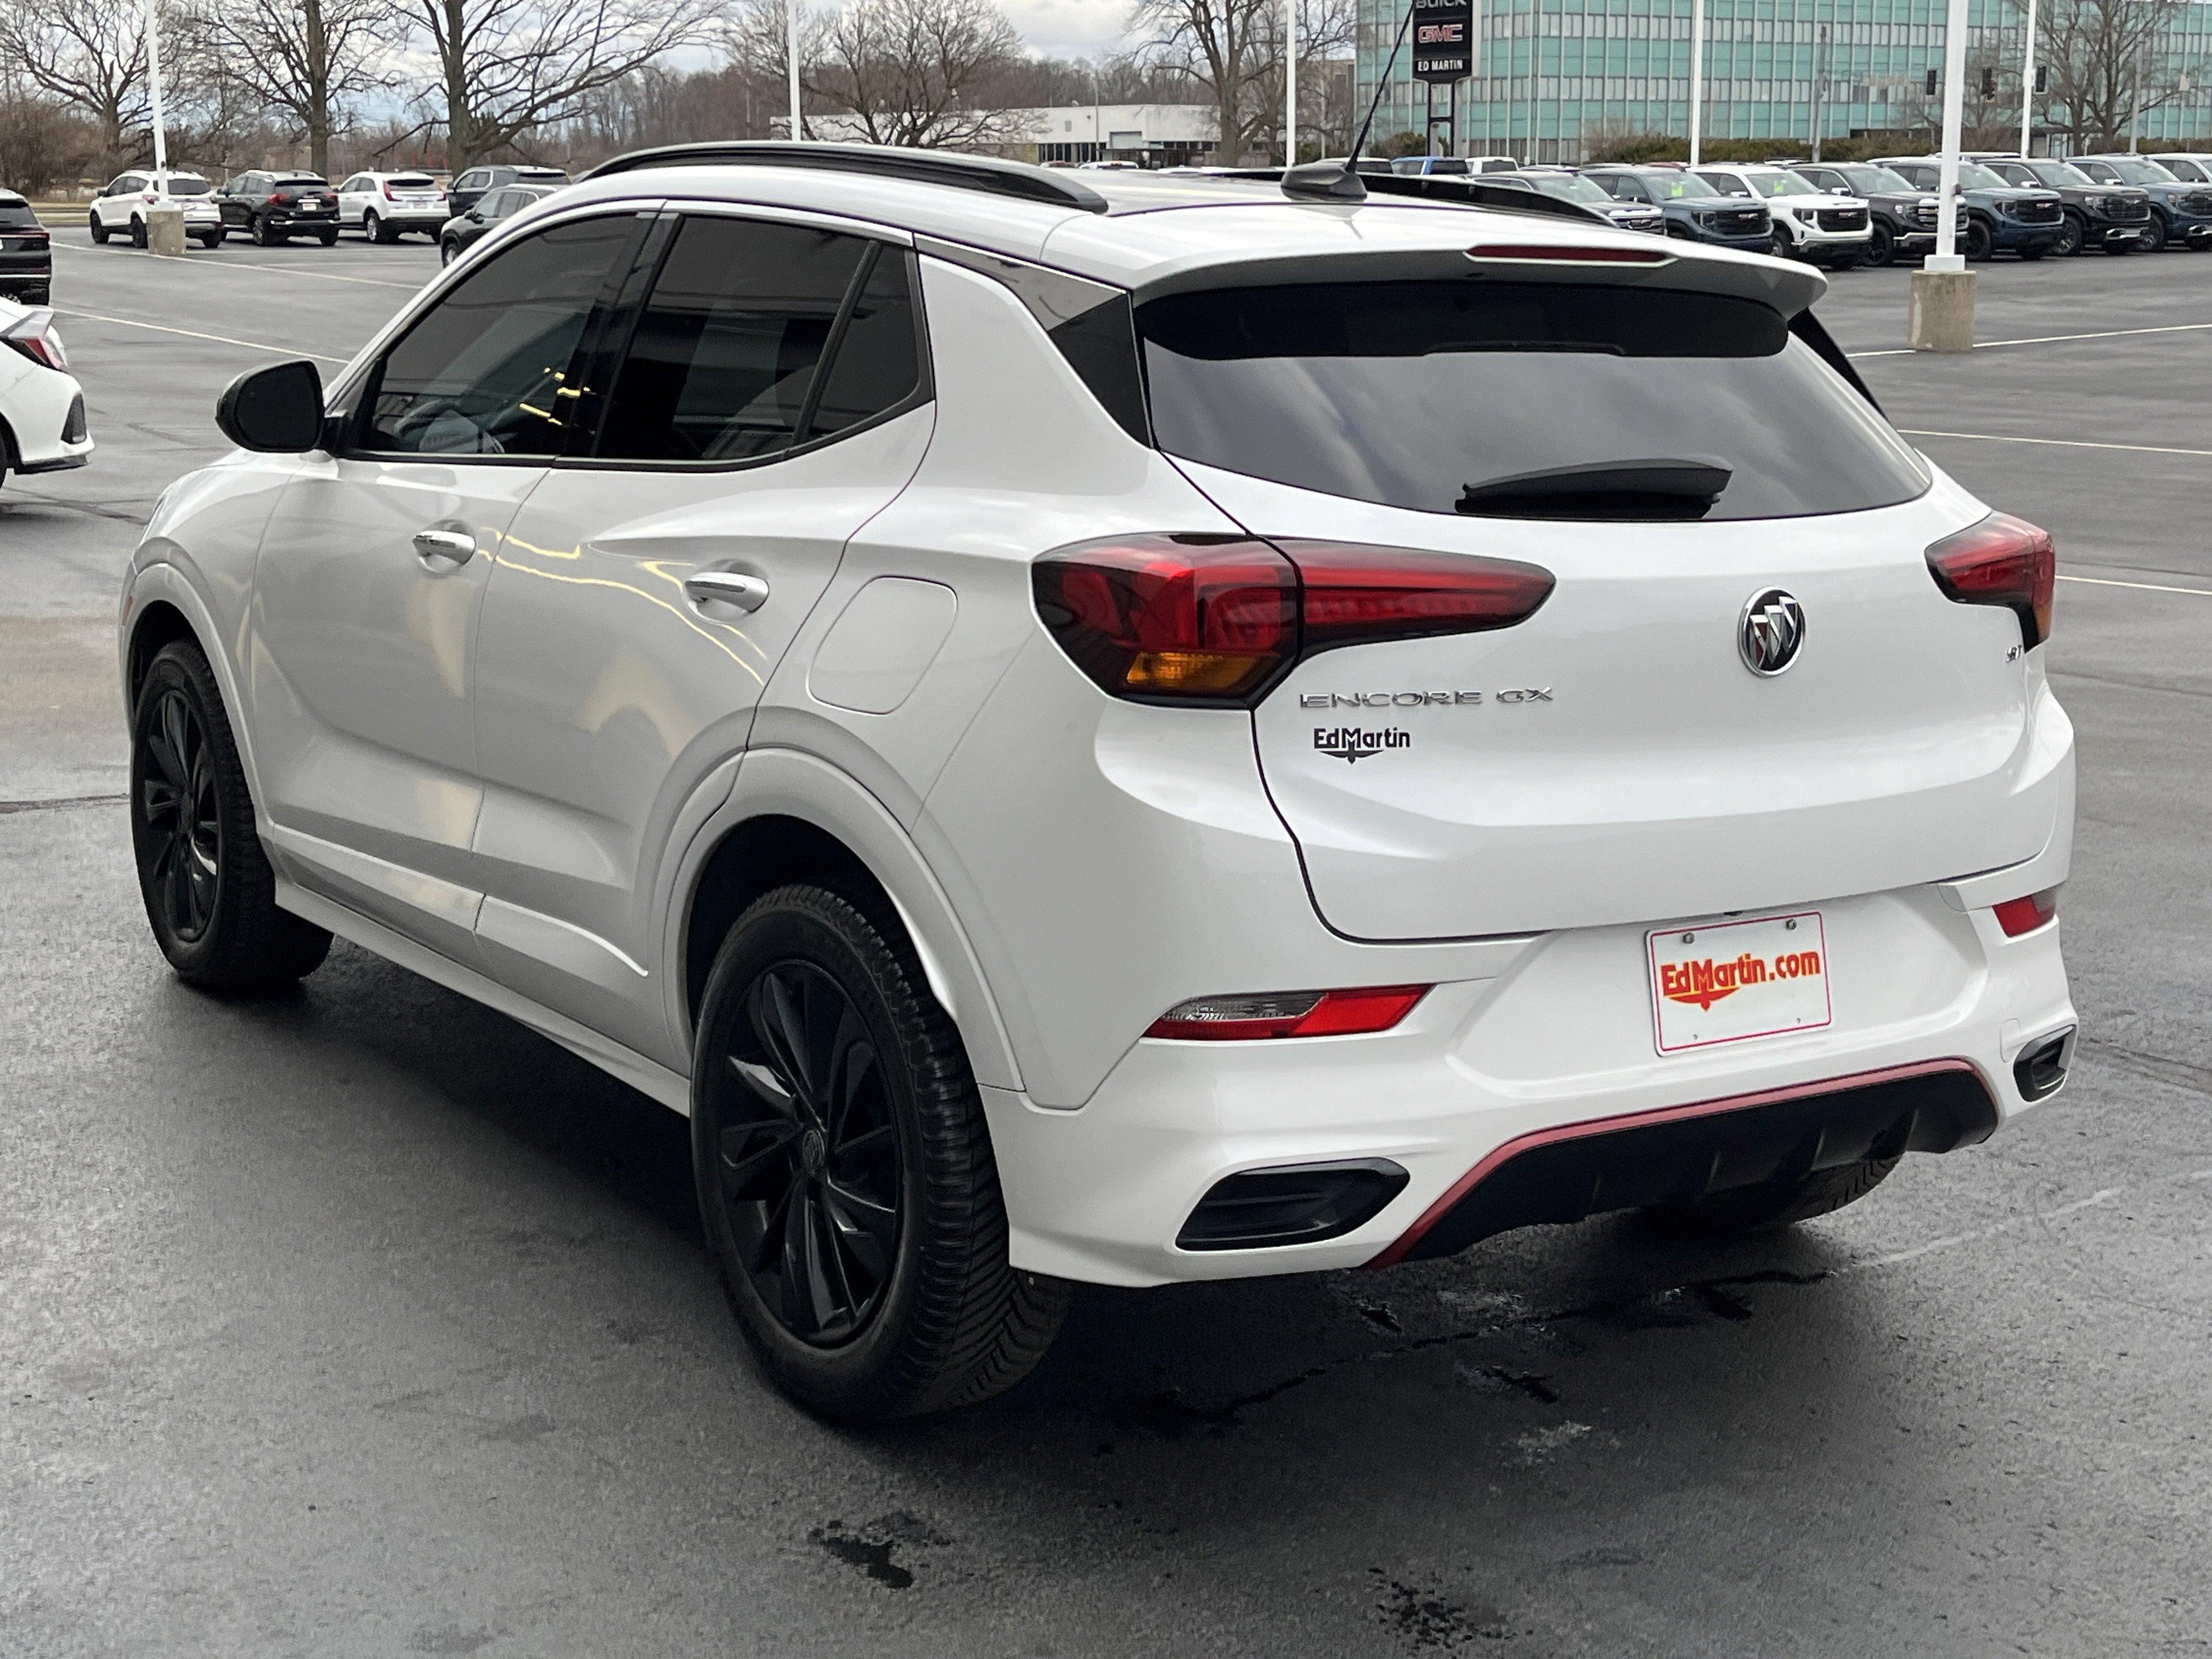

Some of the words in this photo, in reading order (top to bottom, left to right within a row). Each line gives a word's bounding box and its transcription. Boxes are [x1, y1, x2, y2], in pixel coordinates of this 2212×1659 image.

[1418, 24, 1463, 43] GMC
[1418, 60, 1429, 71] ED
[1431, 59, 1463, 71] MARTIN
[1300, 690, 1482, 708] ENCORE
[1496, 686, 1553, 703] GX
[1313, 727, 1410, 750] EdMartin
[1661, 951, 1821, 997] EdMartin.com
